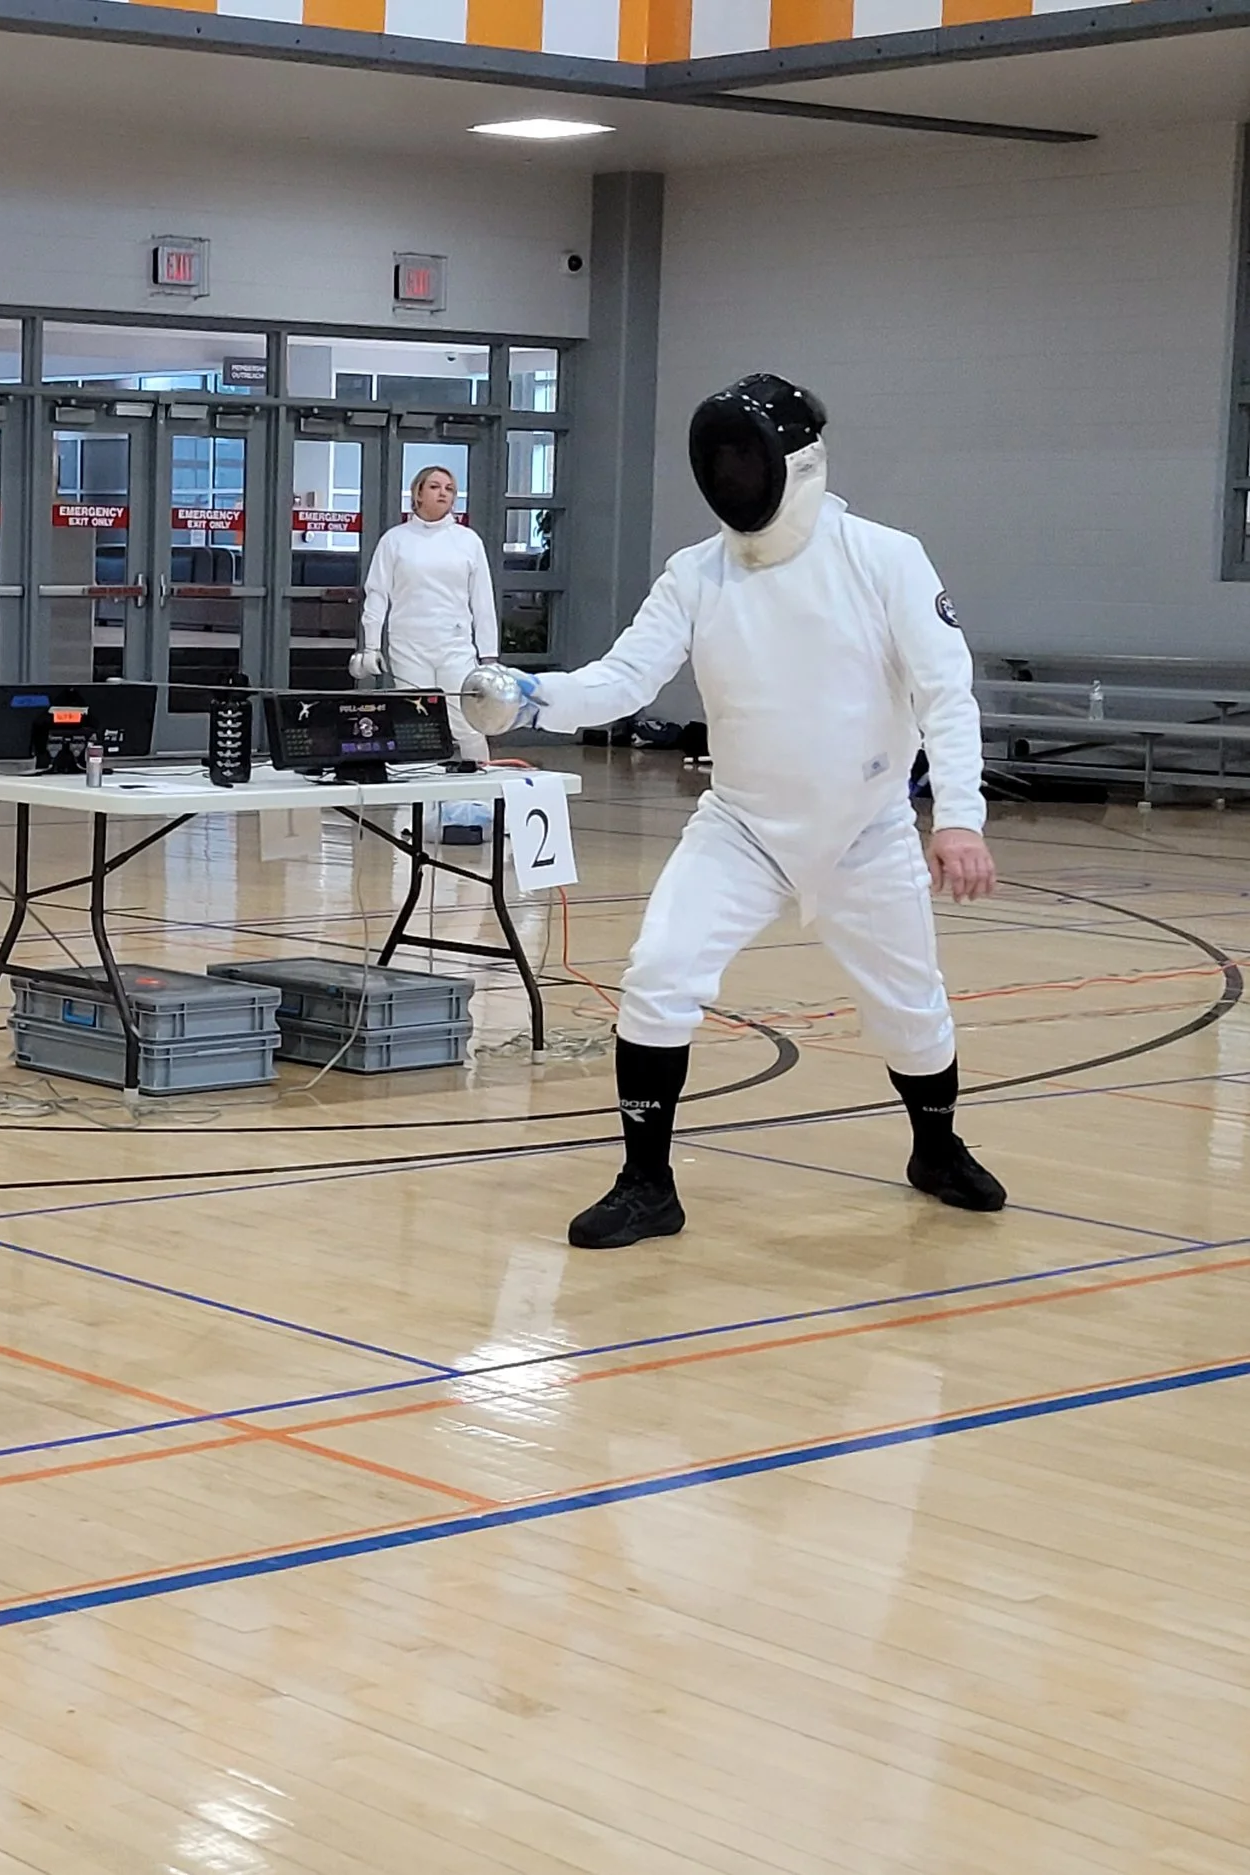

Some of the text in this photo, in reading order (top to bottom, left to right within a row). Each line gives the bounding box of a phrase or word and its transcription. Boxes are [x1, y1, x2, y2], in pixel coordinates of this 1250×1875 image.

[167, 252, 195, 280] EXIT
[59, 506, 124, 518] EMERGENCY
[178, 509, 241, 520] EMERGENCY
[298, 512, 357, 523] EMERGENCY
[68, 517, 115, 527] EXIT ONLY
[187, 520, 231, 529] EXIT ONLY
[307, 522, 348, 531] EXIT ONLY
[526, 808, 556, 868] 2
